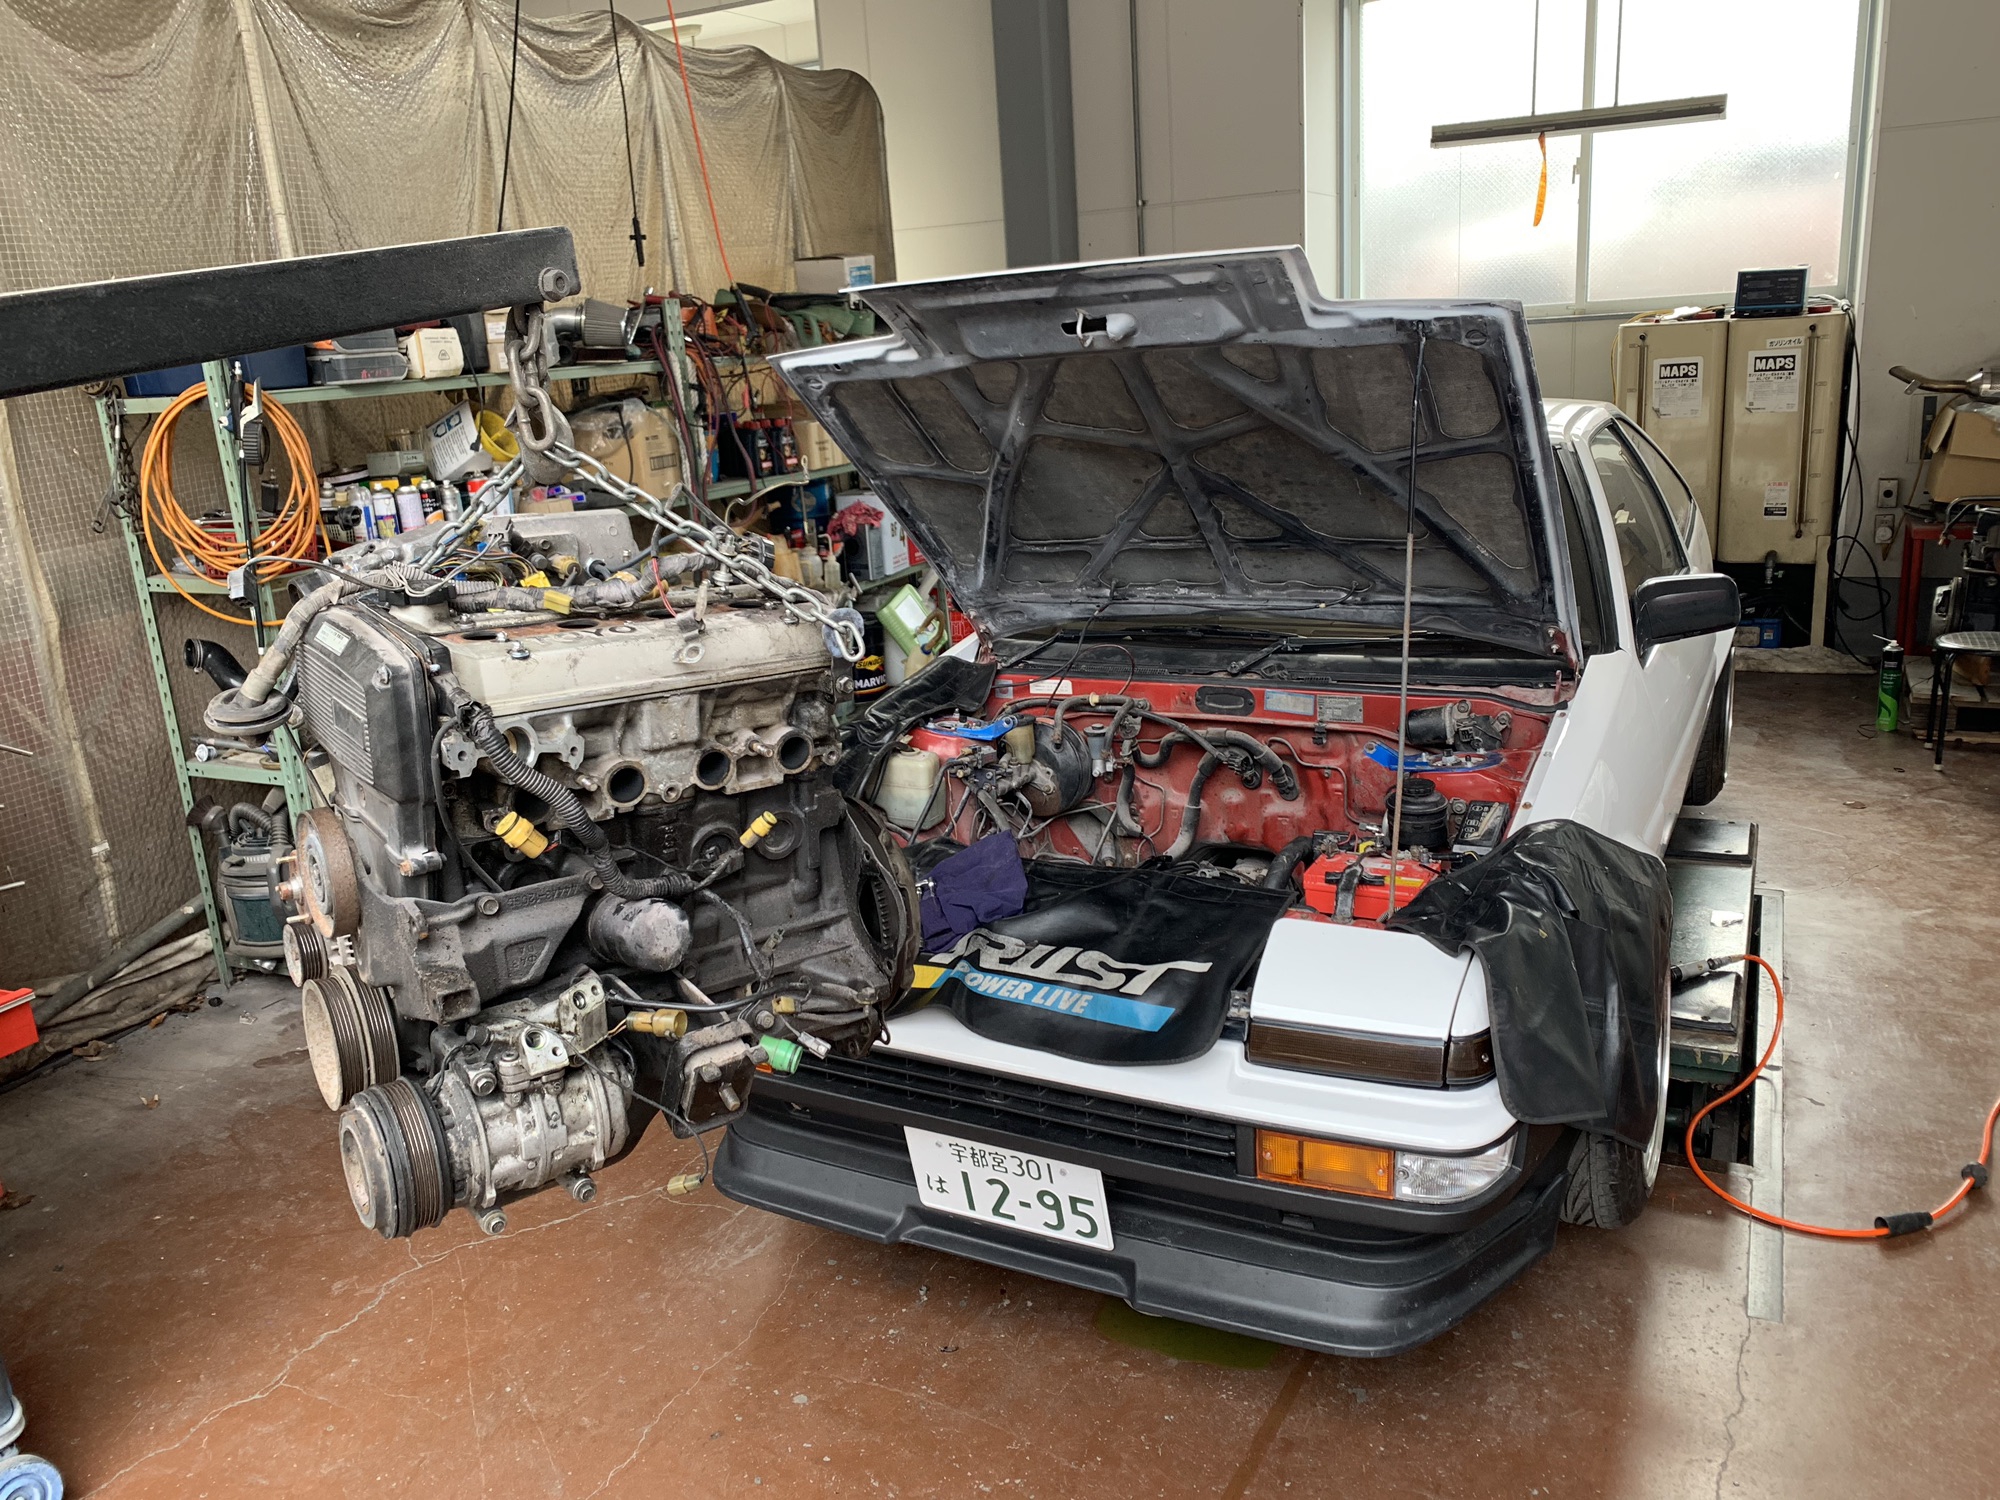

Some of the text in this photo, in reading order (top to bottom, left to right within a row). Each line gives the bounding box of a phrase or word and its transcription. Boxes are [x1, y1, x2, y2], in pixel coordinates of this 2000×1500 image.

[1660, 364, 1697, 378] MAPS
[1755, 357, 1794, 371] MAPS
[951, 959, 1094, 1014] POWER LIVE
[926, 1170, 1099, 1239] は 12-95
